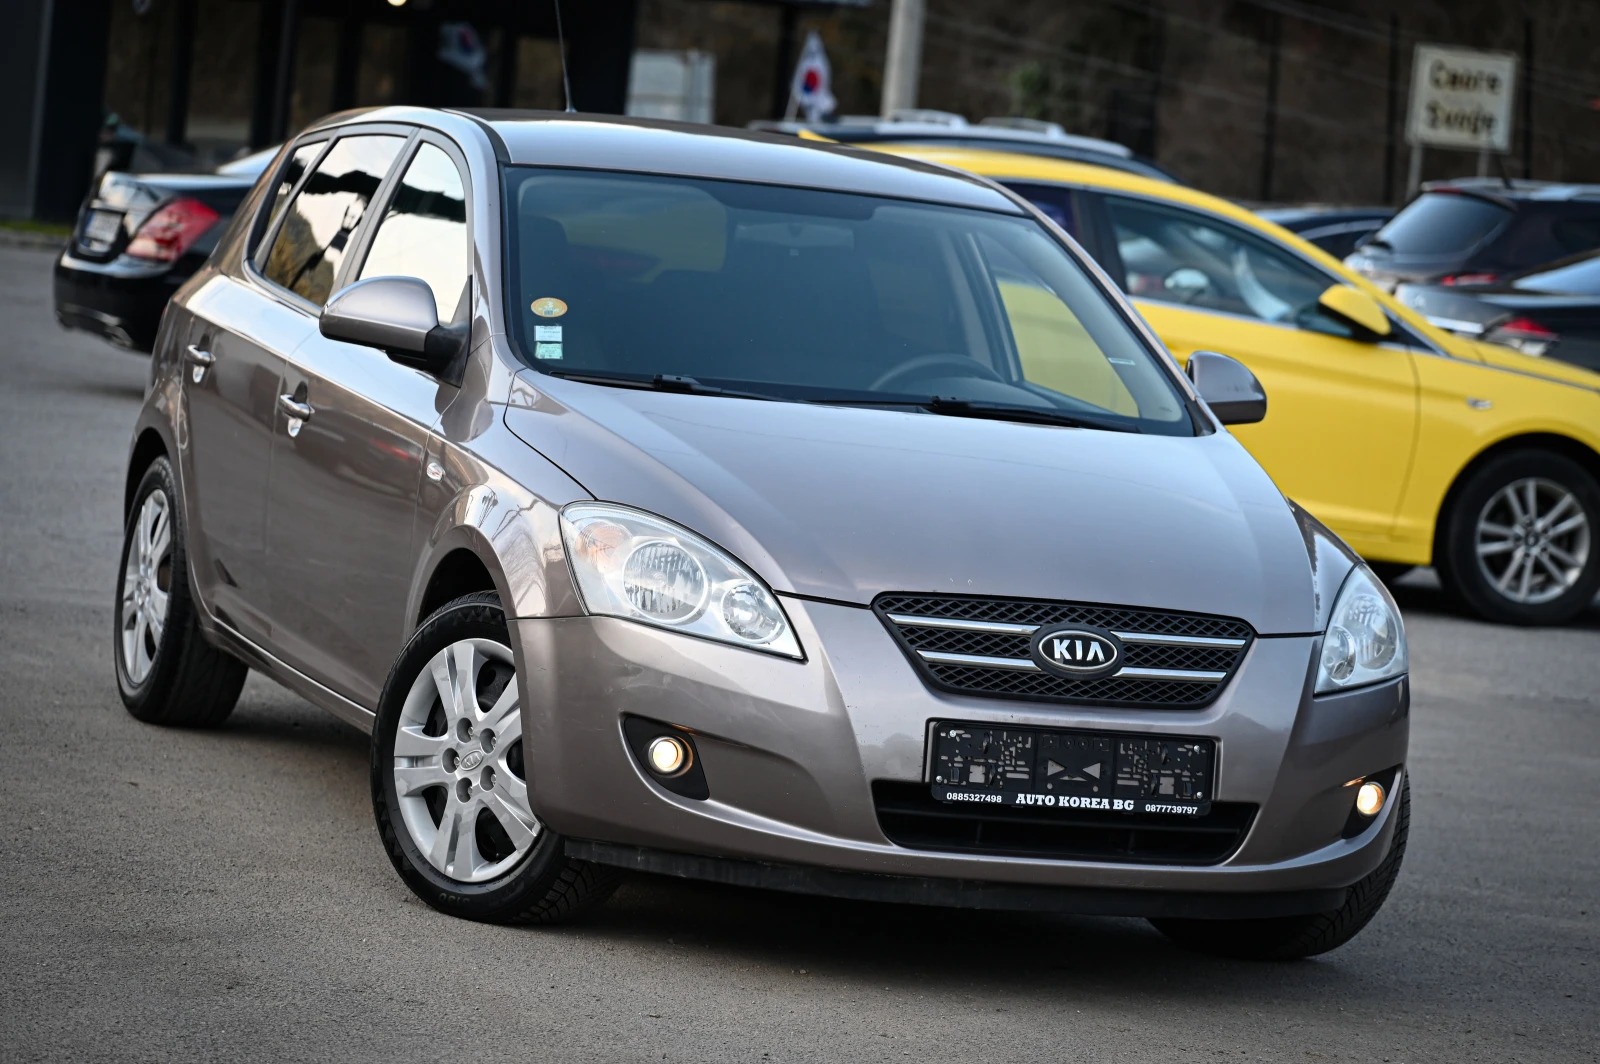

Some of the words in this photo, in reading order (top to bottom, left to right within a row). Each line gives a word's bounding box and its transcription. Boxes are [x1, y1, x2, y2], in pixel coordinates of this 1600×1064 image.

[1052, 638, 1105, 662] KIA
[946, 792, 1002, 803] 0885327498
[1016, 793, 1056, 806] AUTO
[1058, 795, 1110, 809] KOREA
[1113, 798, 1134, 811] BG
[1145, 804, 1198, 815] 0877739797
